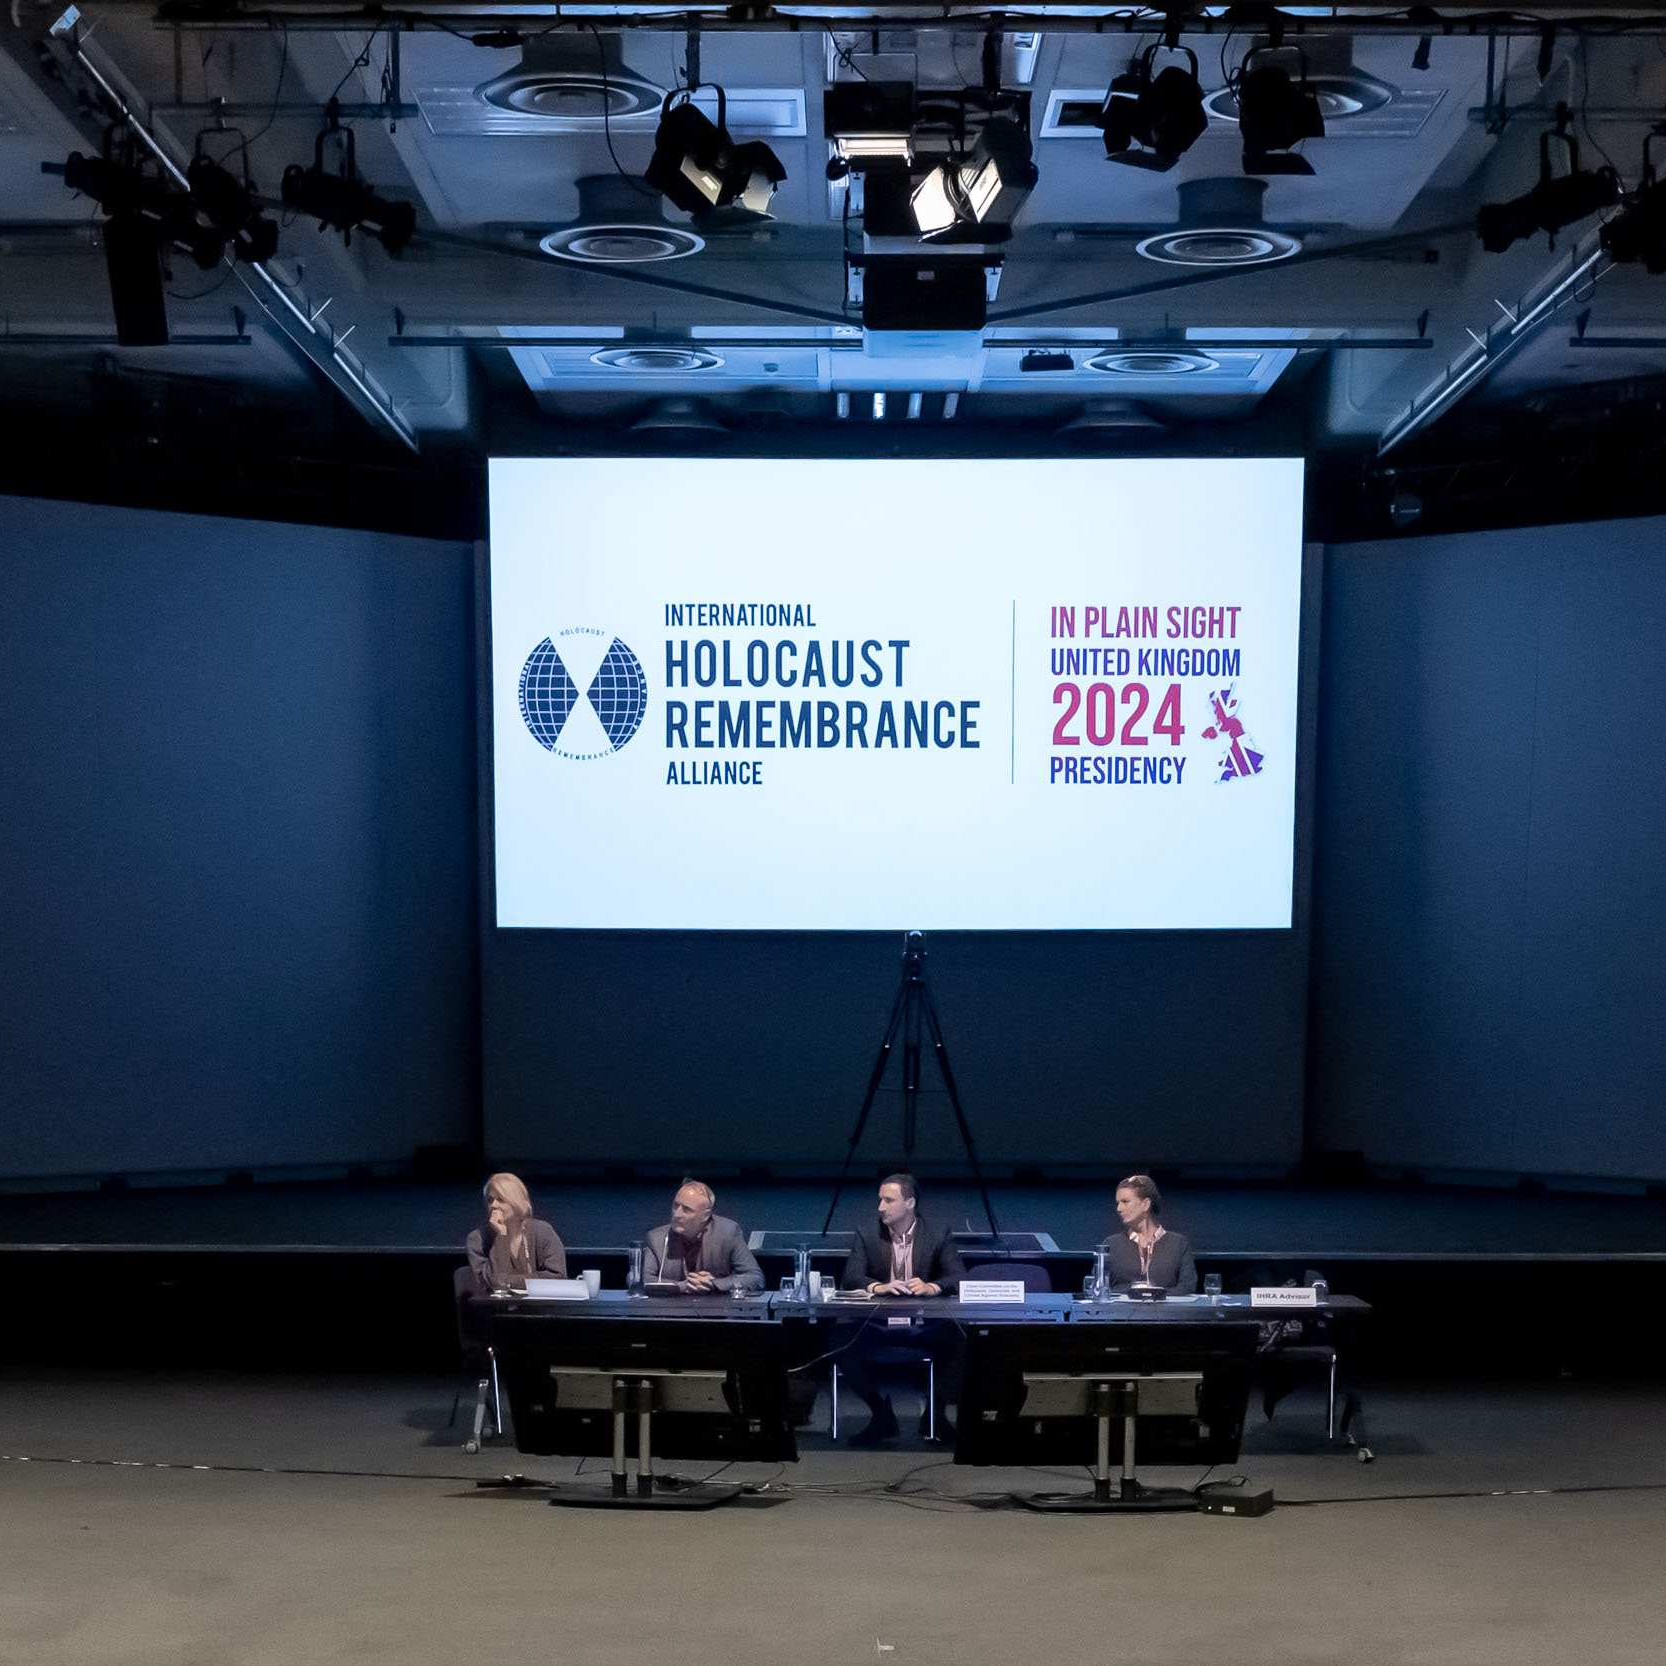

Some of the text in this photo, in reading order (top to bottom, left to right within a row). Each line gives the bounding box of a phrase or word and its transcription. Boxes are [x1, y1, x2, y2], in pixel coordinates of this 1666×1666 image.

[665, 604, 816, 626] INTERNATIONAL
[1051, 606, 1242, 638] IN PLAIN SIGHT
[666, 640, 910, 687] HOLOCAUST
[1051, 648, 1240, 676] UNITED KINGDOM
[666, 700, 980, 749] REMEMBRANCE
[1052, 682, 1185, 746] 2024
[666, 761, 763, 785] ALLIANCE
[1050, 756, 1187, 784] PRESIDENCY
